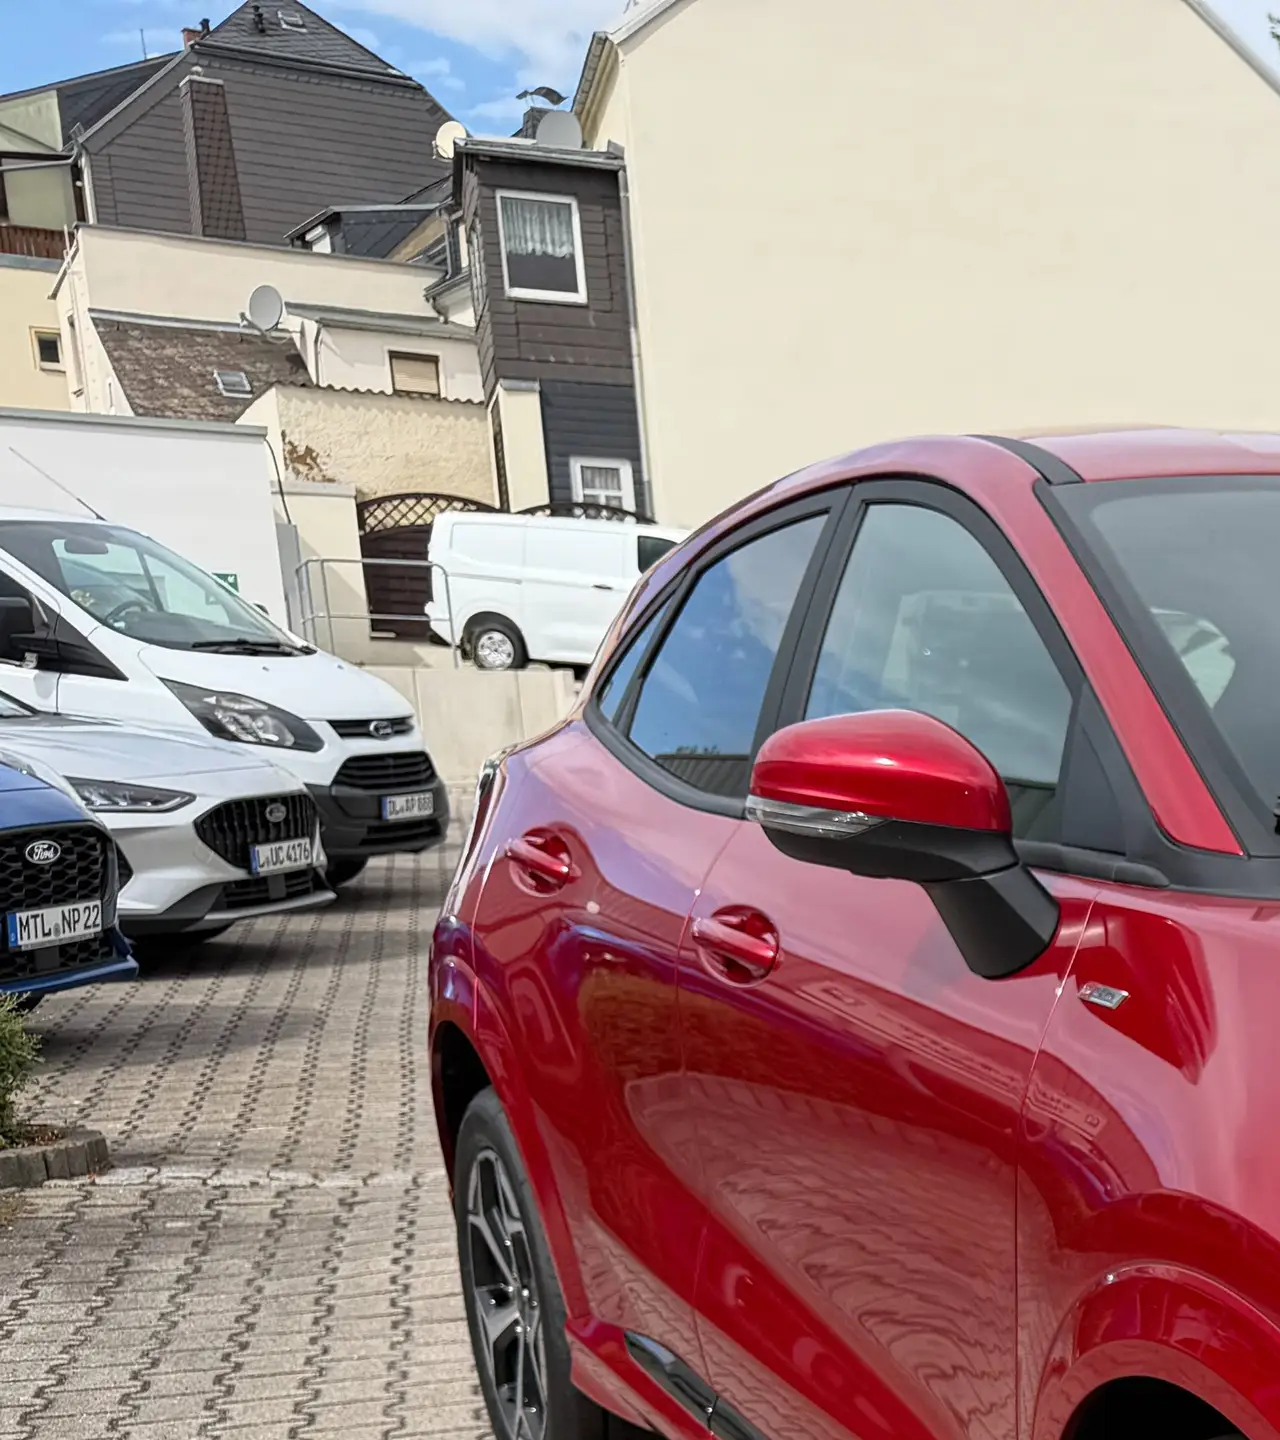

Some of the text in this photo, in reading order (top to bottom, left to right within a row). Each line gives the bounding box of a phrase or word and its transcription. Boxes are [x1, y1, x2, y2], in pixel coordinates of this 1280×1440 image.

[18, 912, 52, 941] MTL
[61, 908, 81, 934] NP
[83, 904, 100, 930] 22
